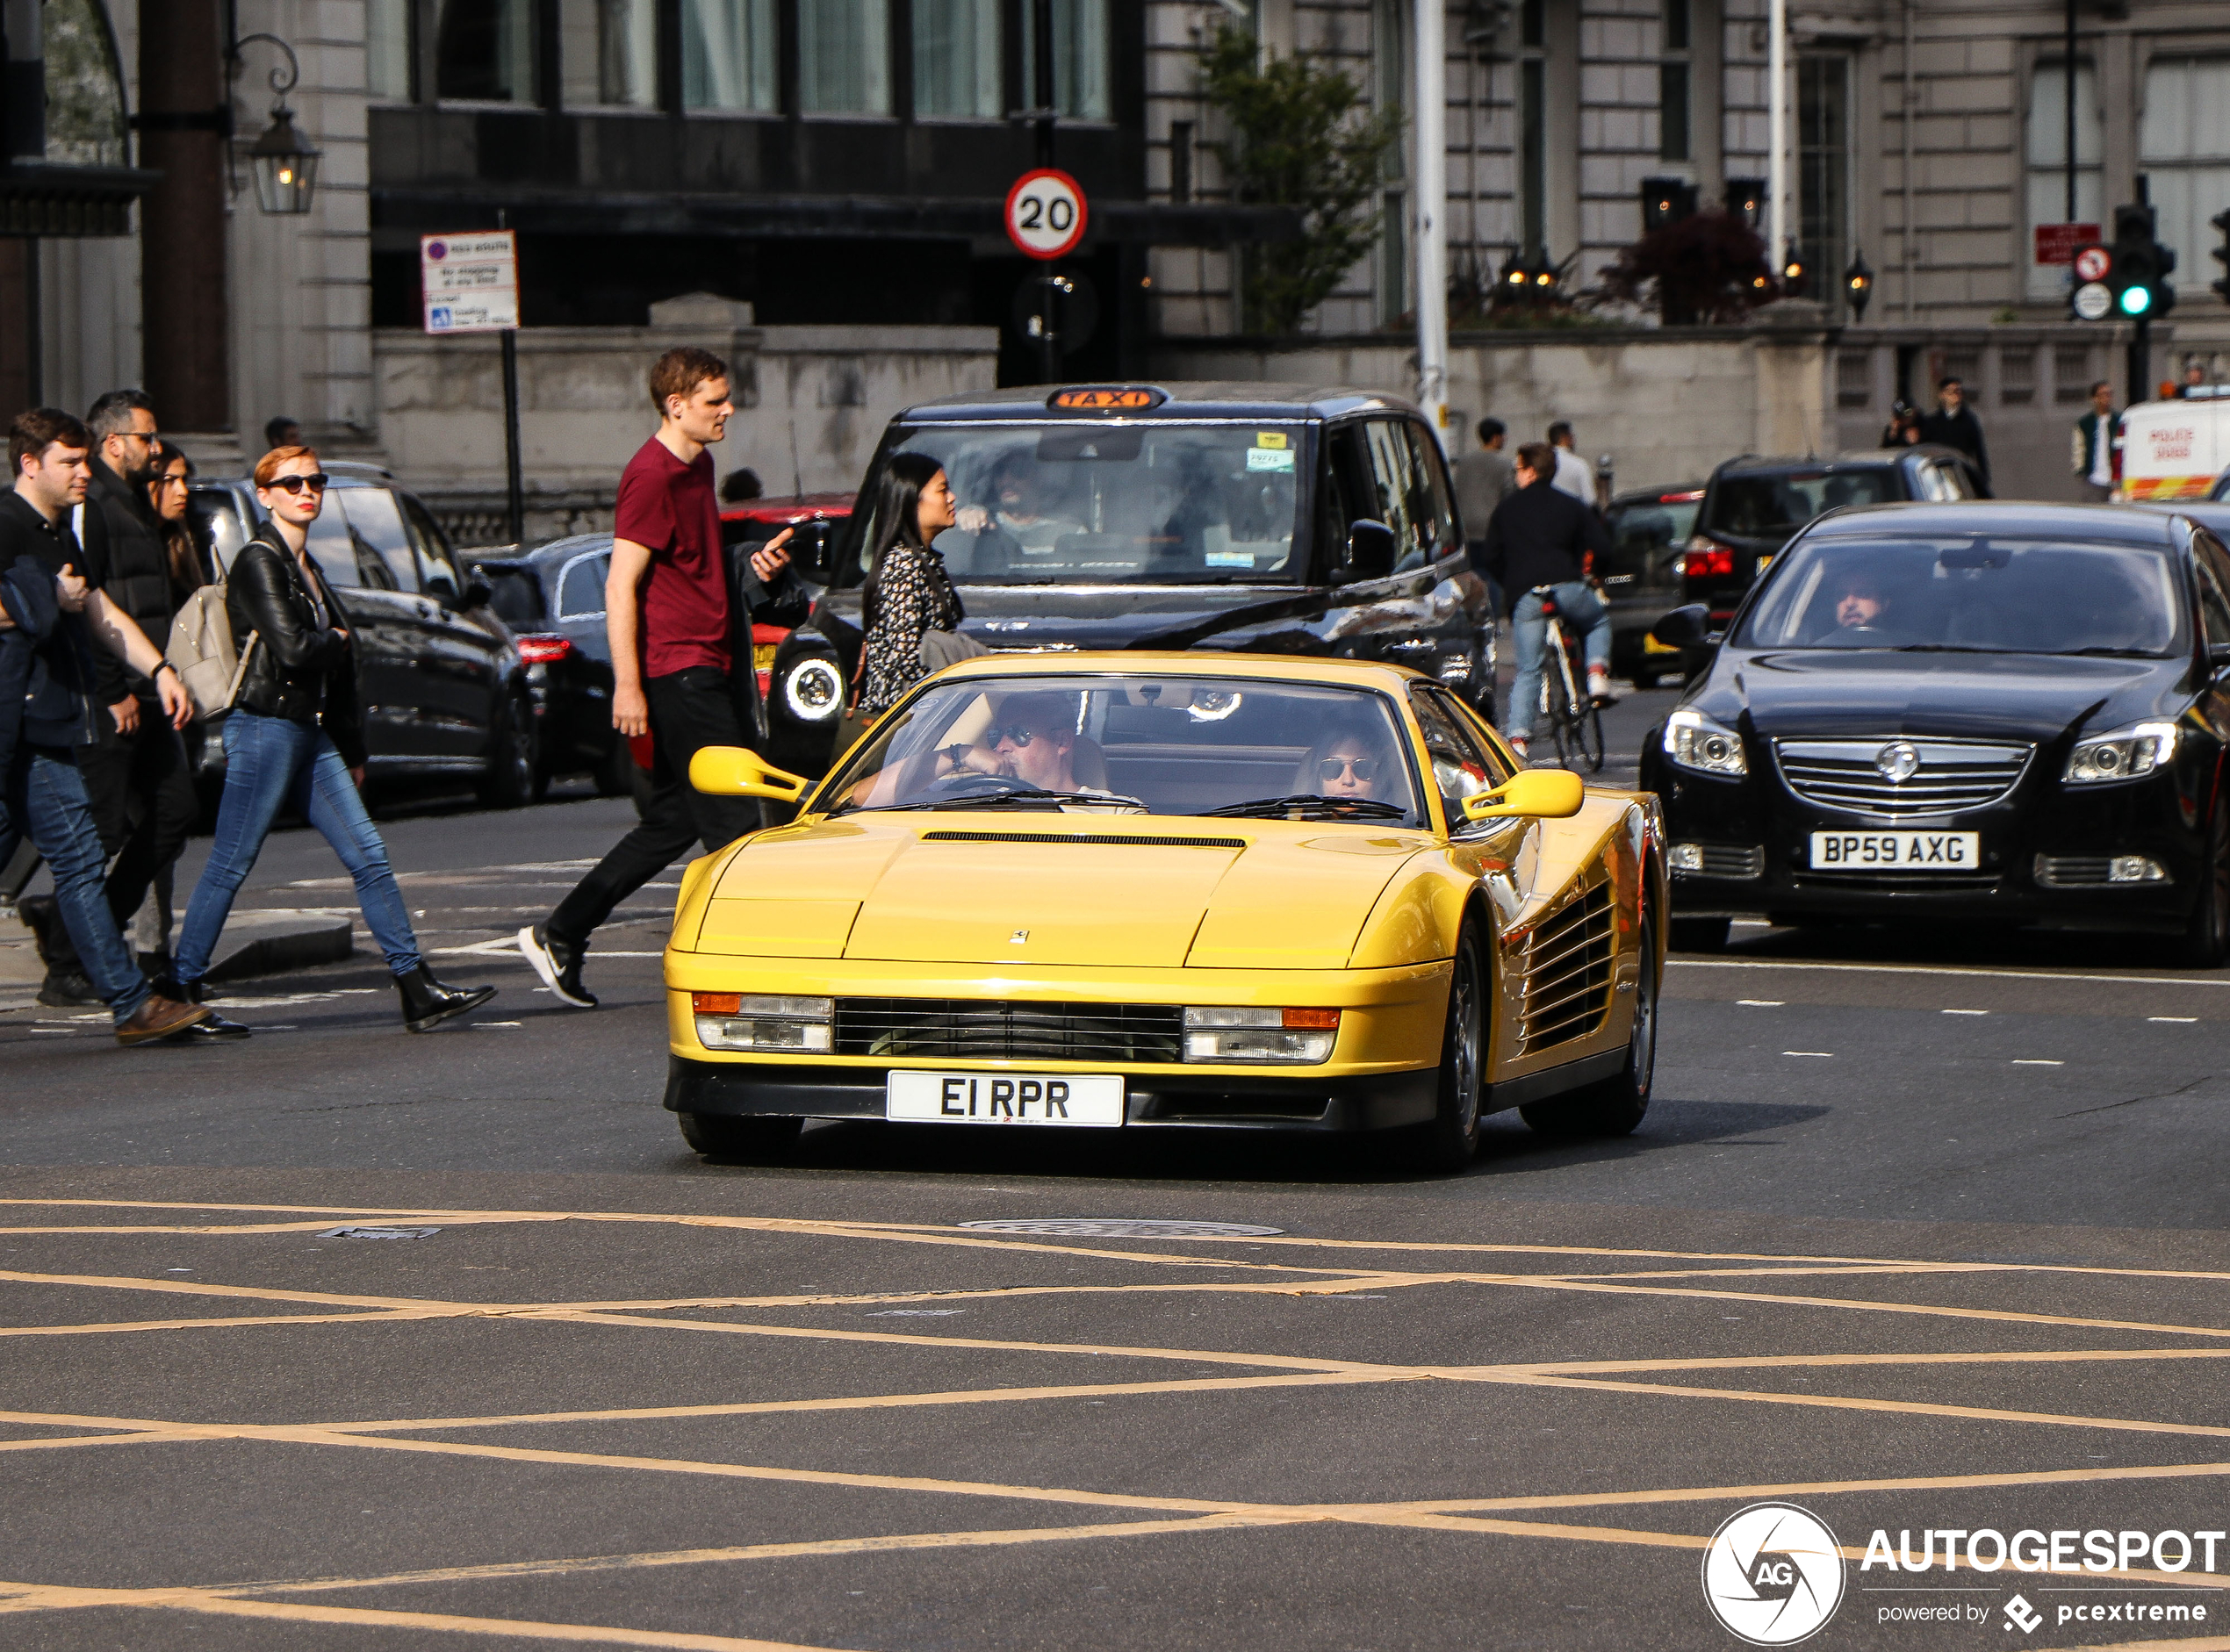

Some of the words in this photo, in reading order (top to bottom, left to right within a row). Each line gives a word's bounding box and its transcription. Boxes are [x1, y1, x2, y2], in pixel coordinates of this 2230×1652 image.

[1020, 195, 1073, 231] 20
[1067, 391, 1141, 405] TAXI
[1824, 836, 1898, 862] BP59
[1908, 836, 1965, 862] AXG
[990, 1080, 1070, 1118] RPR
